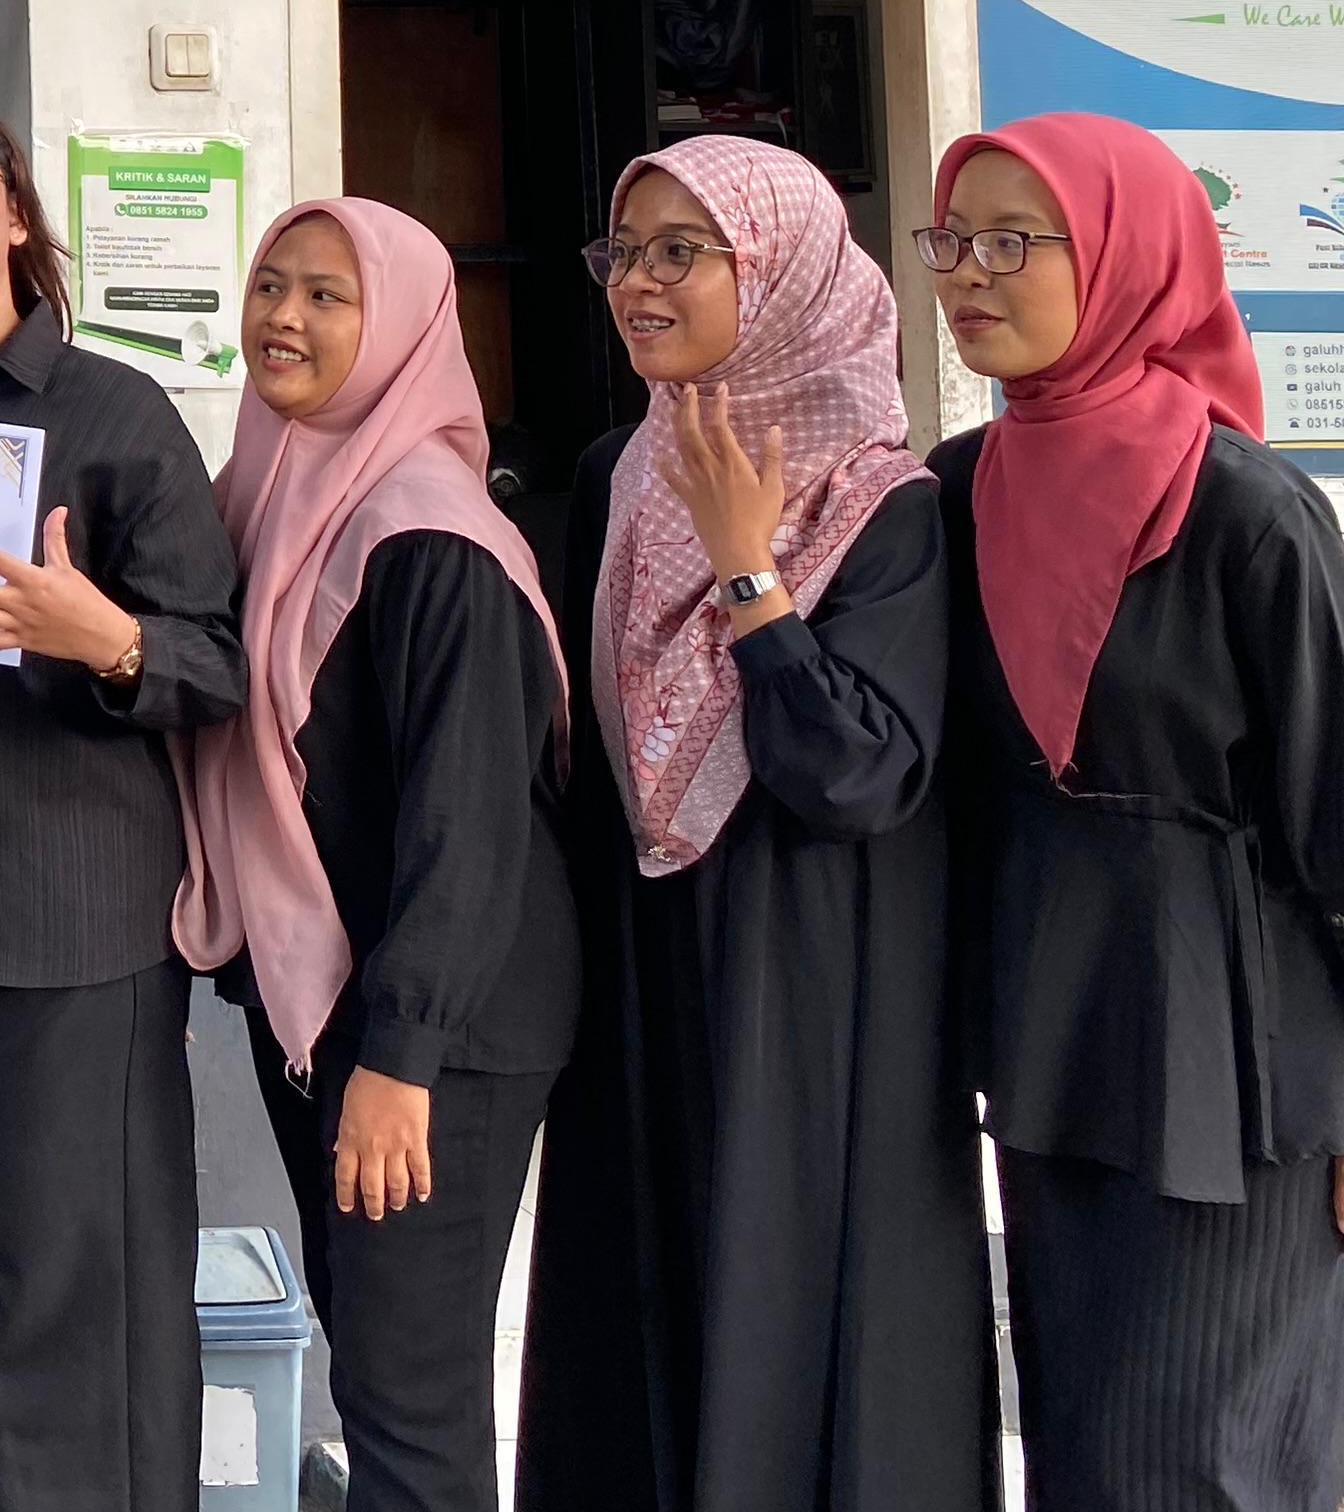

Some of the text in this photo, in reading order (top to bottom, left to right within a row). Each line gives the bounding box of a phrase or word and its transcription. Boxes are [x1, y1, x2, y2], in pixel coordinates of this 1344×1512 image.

[1243, 3, 1269, 25] We
[1277, 5, 1321, 27] Care
[116, 172, 207, 184] KRITIK & SARAN
[130, 207, 153, 216] 0851
[1305, 381, 1341, 394] galuh
